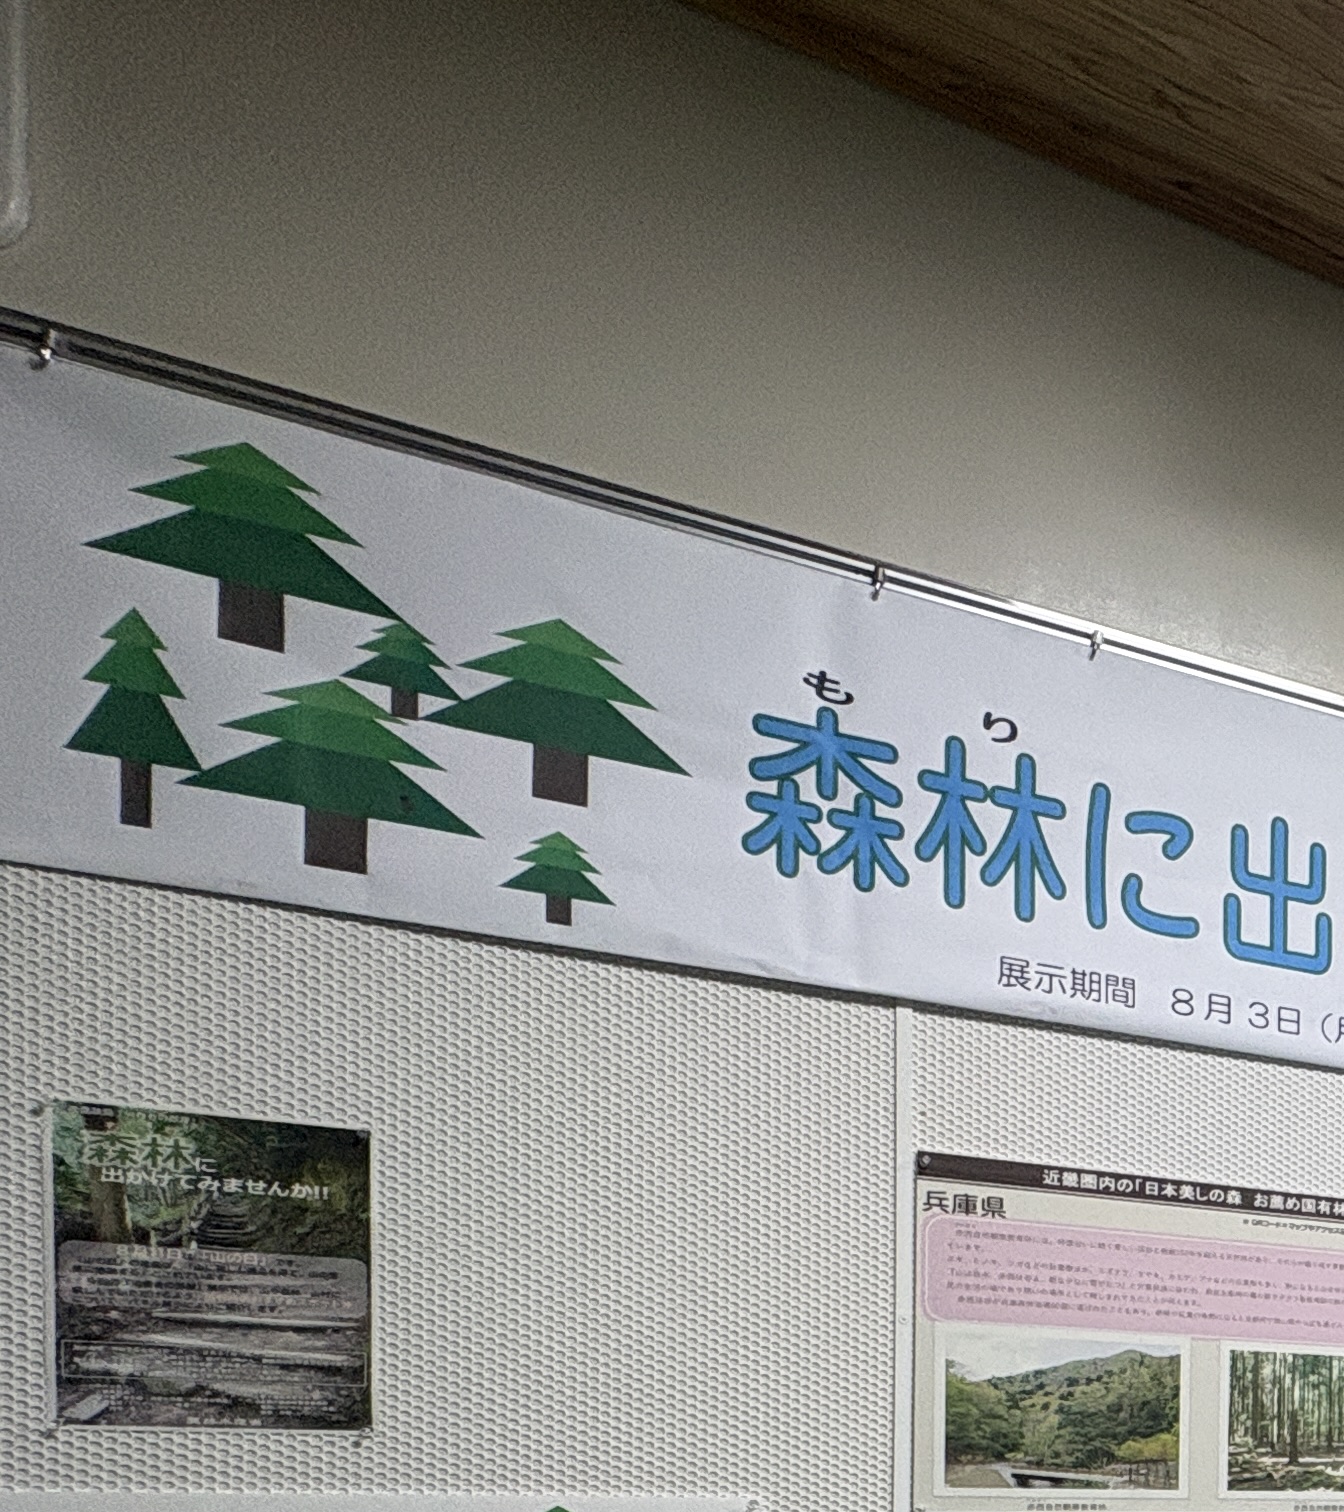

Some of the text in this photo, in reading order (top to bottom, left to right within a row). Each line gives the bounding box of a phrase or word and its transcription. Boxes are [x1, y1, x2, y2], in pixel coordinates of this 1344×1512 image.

[997, 955, 1136, 1009] 展示期間
[922, 1190, 1006, 1220] 兵庫県
[1043, 1169, 1241, 1208] 近畿圏内の「日本美しの森
